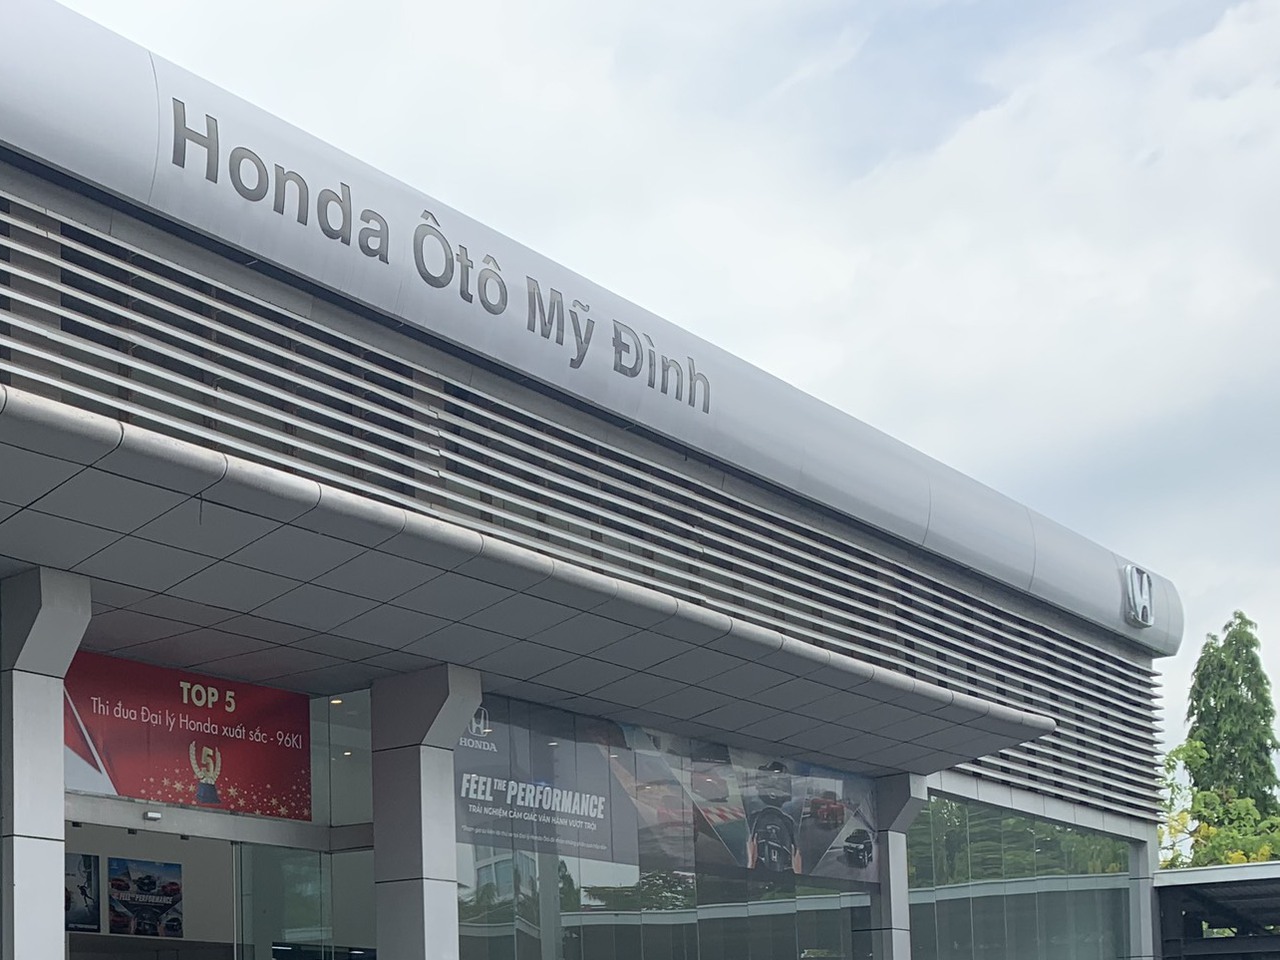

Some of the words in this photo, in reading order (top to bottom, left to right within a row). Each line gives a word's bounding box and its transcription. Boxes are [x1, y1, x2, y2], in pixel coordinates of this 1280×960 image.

[171, 97, 390, 266] Honda
[412, 209, 509, 316] Ôtô
[525, 275, 596, 370] Mỹ
[611, 318, 711, 415] Đình
[90, 696, 110, 716] Thi
[113, 701, 137, 721] đua
[140, 706, 162, 727] Đại
[165, 709, 176, 732] lý
[179, 713, 219, 735] Honda
[221, 723, 246, 740] xuất
[248, 726, 268, 744] sắc
[179, 681, 219, 708] TOP
[224, 690, 236, 713] 5
[459, 737, 498, 752] HONDA
[460, 773, 494, 802] FEEL
[493, 778, 507, 792] THE
[506, 780, 606, 819] PERFORMANCE
